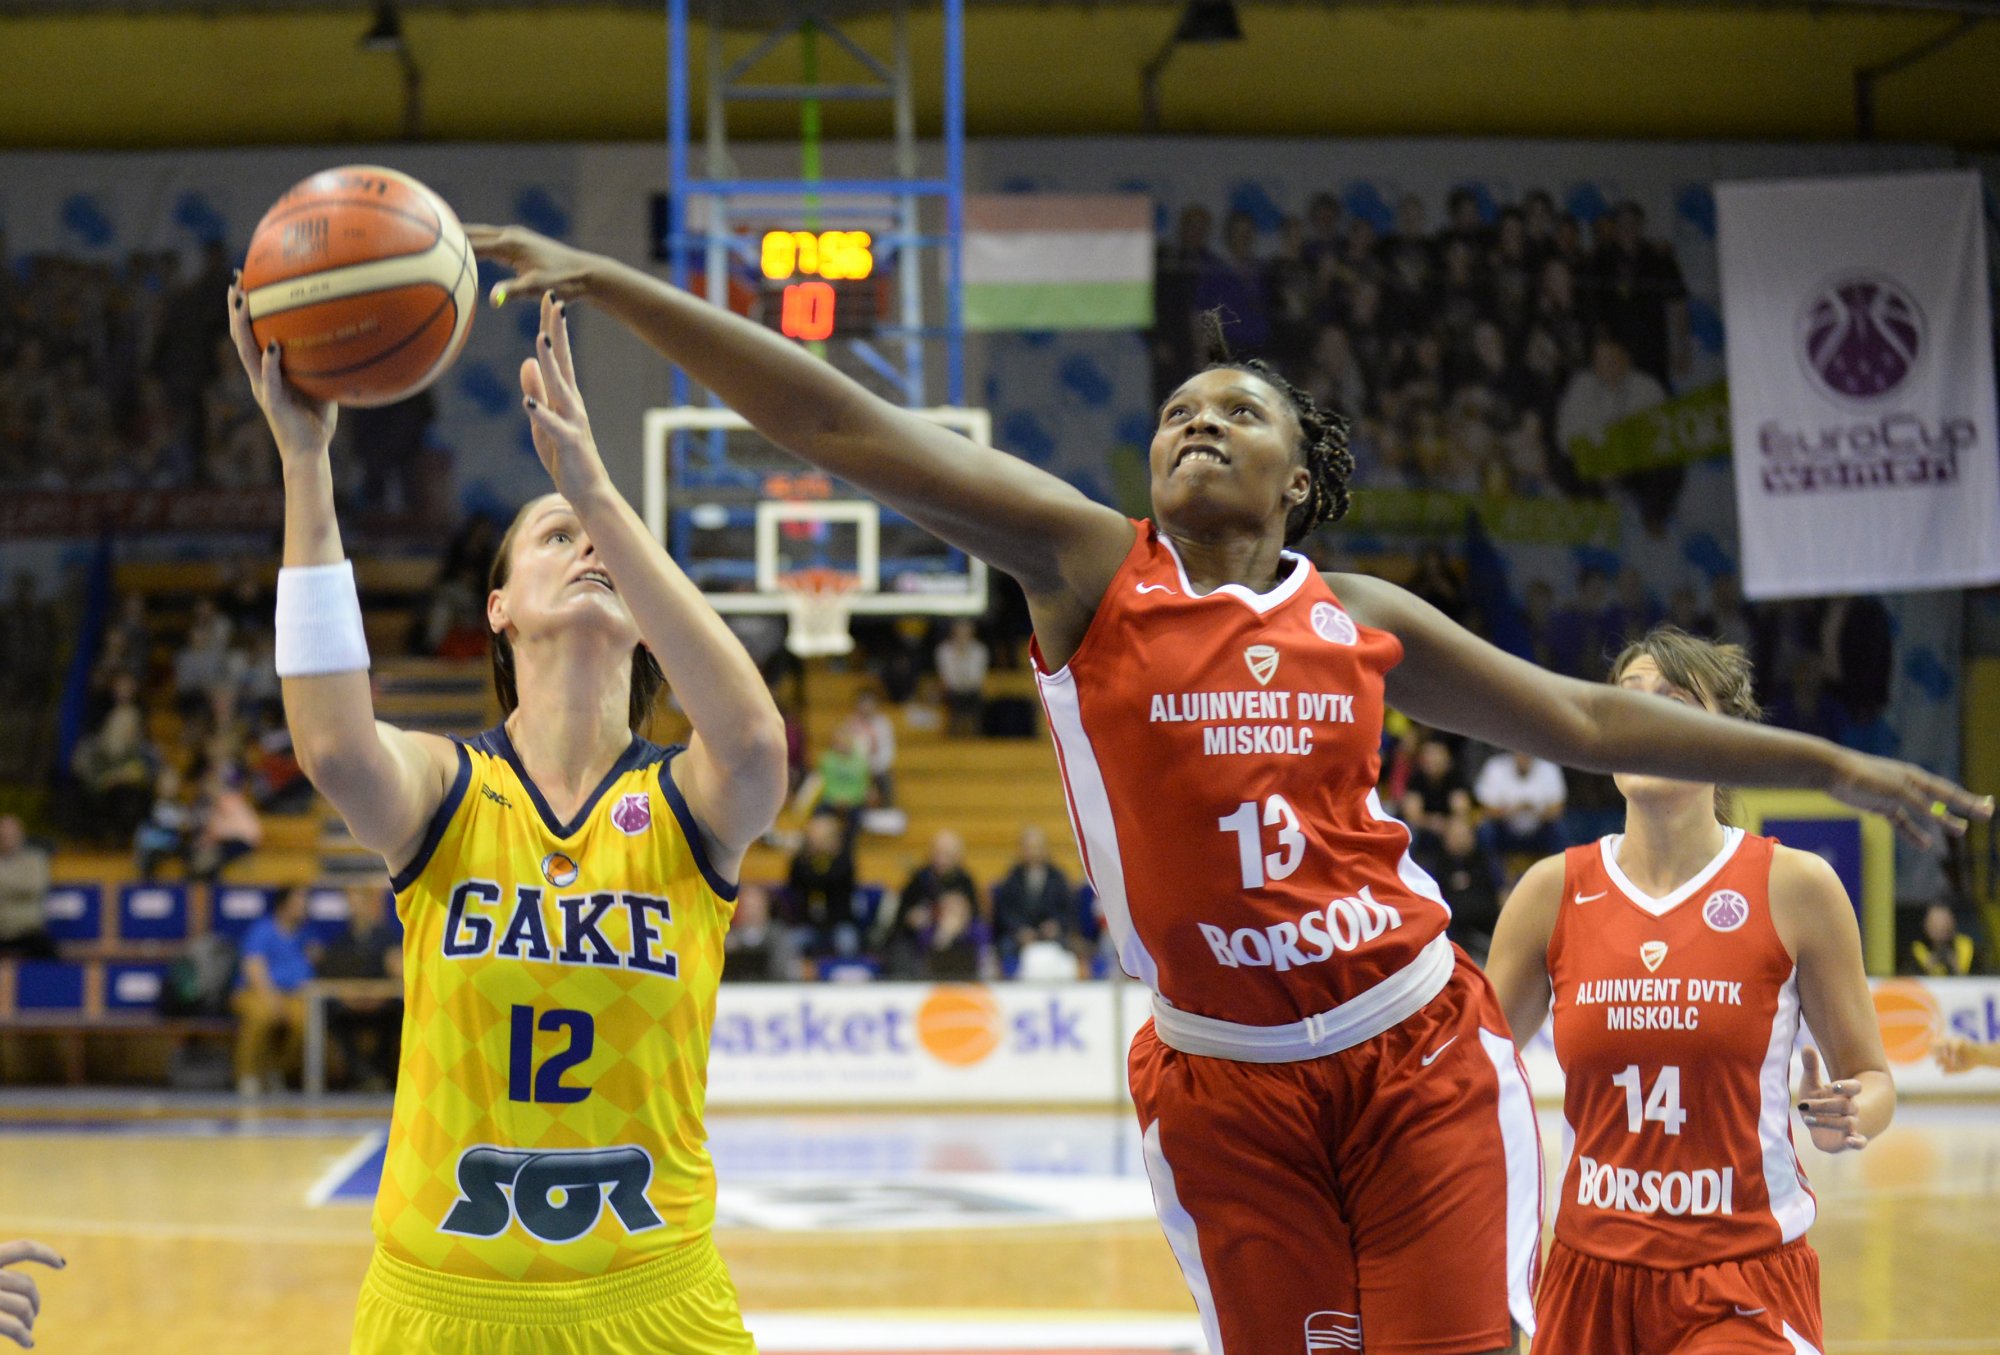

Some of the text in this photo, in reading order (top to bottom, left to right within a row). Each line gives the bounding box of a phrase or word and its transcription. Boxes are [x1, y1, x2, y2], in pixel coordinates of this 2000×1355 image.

[782, 282, 835, 340] 10
[1150, 691, 1355, 723] ALUINVENT DVTK
[1203, 726, 1313, 756] MISKOLC
[1218, 794, 1306, 889] 13
[443, 877, 680, 980] GAKE
[1196, 885, 1402, 972] BORSODI
[1575, 978, 1742, 1006] ALUINVENT DVTK
[1607, 1006, 1699, 1031] MISKOLC
[508, 1004, 594, 1104] 12
[1612, 1064, 1686, 1135] 14
[436, 1144, 667, 1244] SOR
[1577, 1154, 1733, 1216] BORSODI
